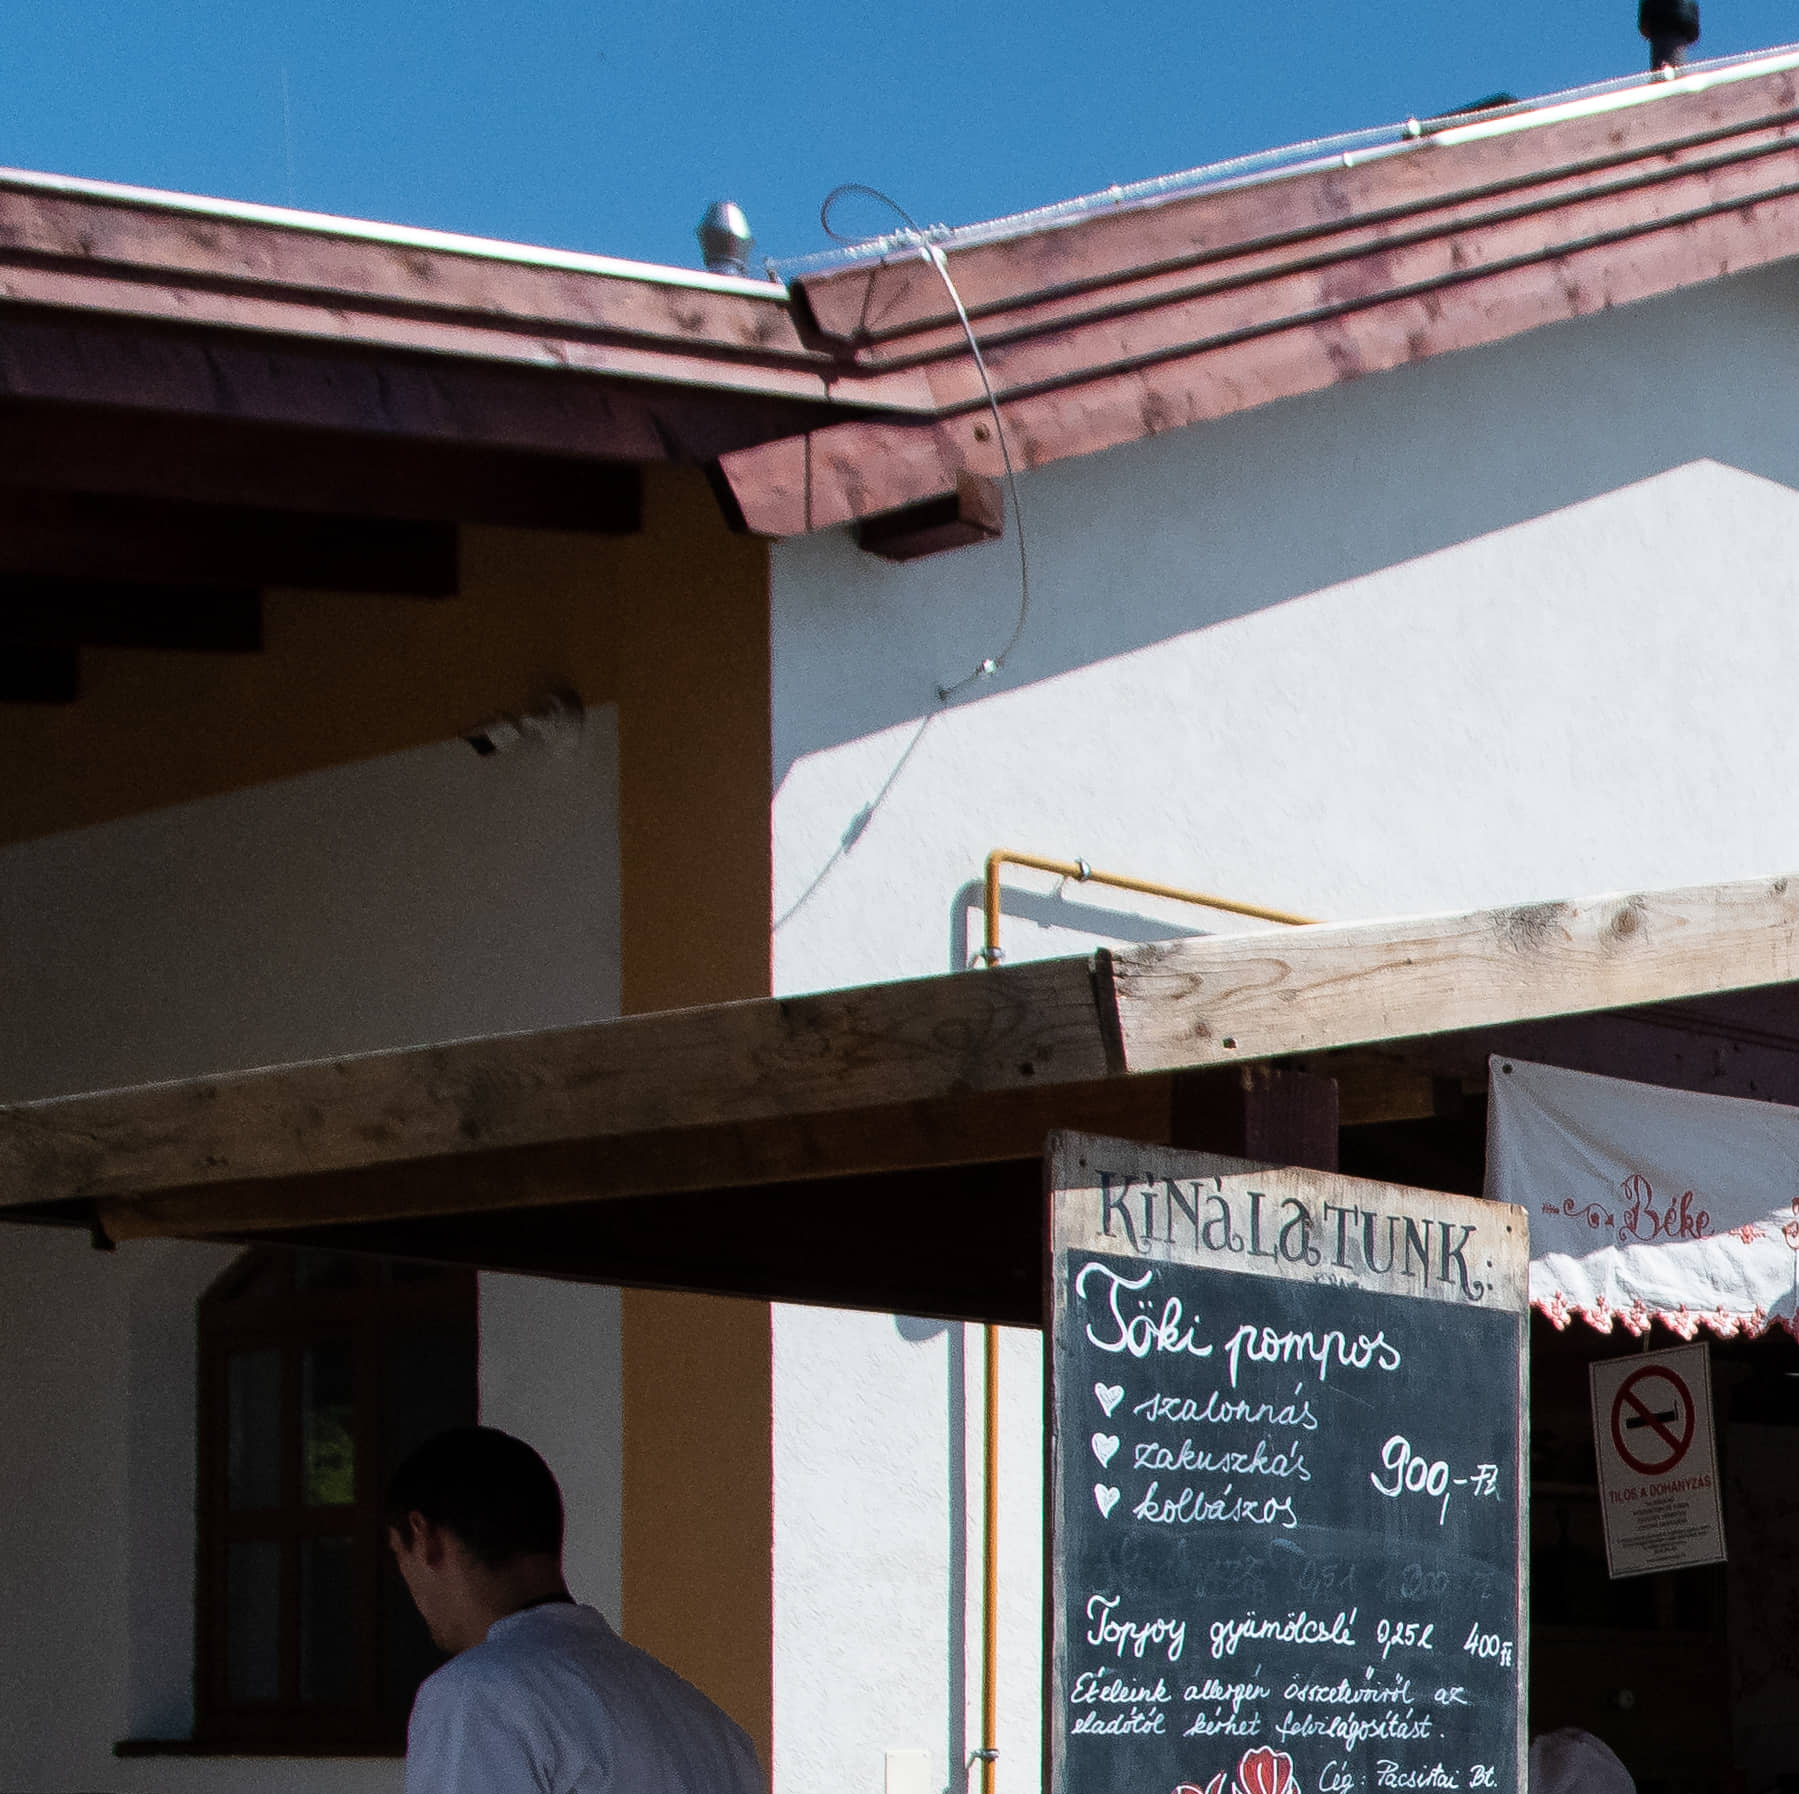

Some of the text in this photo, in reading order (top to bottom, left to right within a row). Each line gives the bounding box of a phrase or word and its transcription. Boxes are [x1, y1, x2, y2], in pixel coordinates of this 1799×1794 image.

[1619, 1173, 1714, 1243] Béke
[1076, 1261, 1401, 1388] Töki pompos
[1133, 1384, 1319, 1430] szalonnás
[1134, 1441, 1311, 1481] zakuszkás
[1132, 1482, 1298, 1528] kolbászos
[1609, 1488, 1637, 1504] TILOS
[1639, 1487, 1648, 1498] A
[1210, 1607, 1357, 1657] gyümölcslé
[1184, 1665, 1270, 1713] allergén
[1434, 1687, 1468, 1706] az
[1071, 1708, 1166, 1735] eladótól
[1184, 1708, 1260, 1737] kérhet
[1469, 1764, 1497, 1788] Bt.
